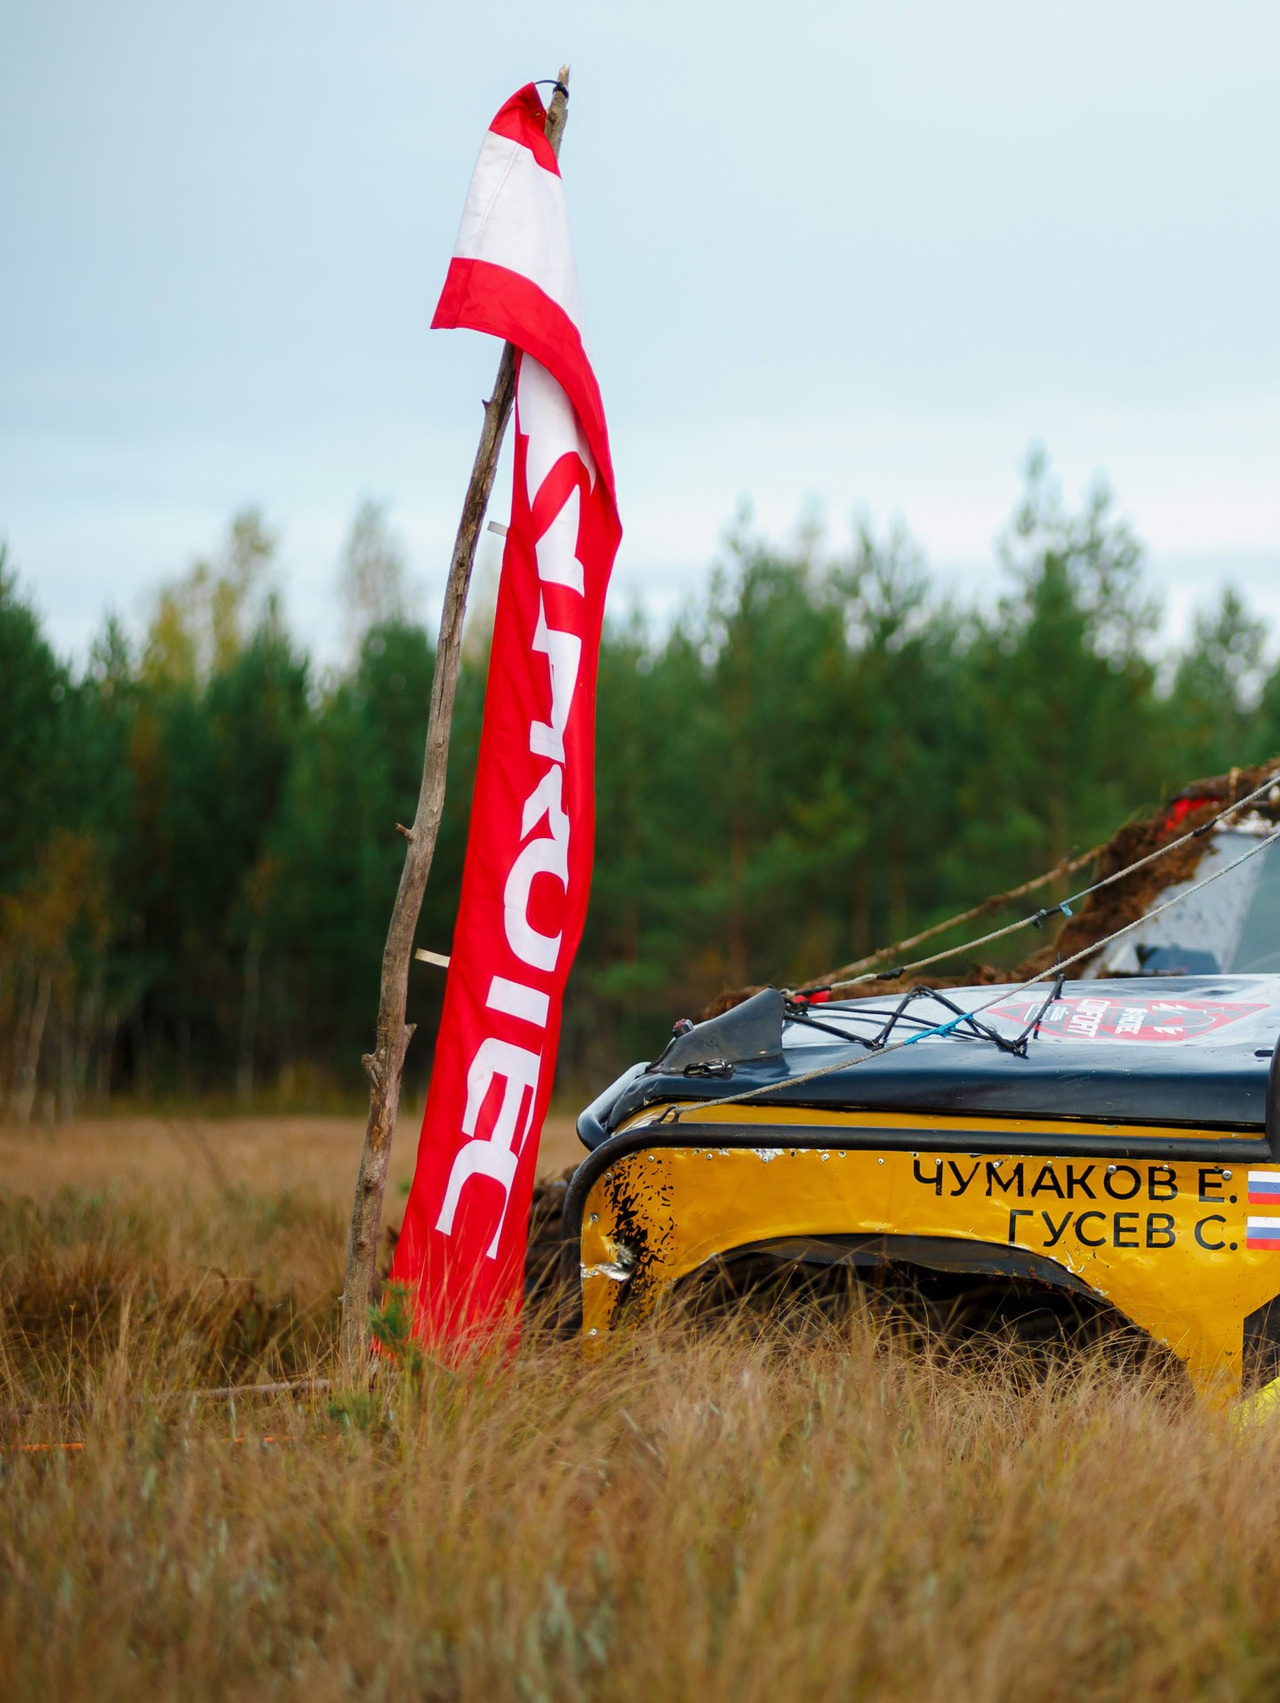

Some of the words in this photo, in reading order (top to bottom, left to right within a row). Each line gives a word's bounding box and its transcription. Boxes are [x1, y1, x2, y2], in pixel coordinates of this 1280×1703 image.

[913, 1157, 1178, 1201] ЧУМАКОВ
[1008, 1209, 1176, 1249] ГУСЕВ
[1194, 1214, 1238, 1251] С.
